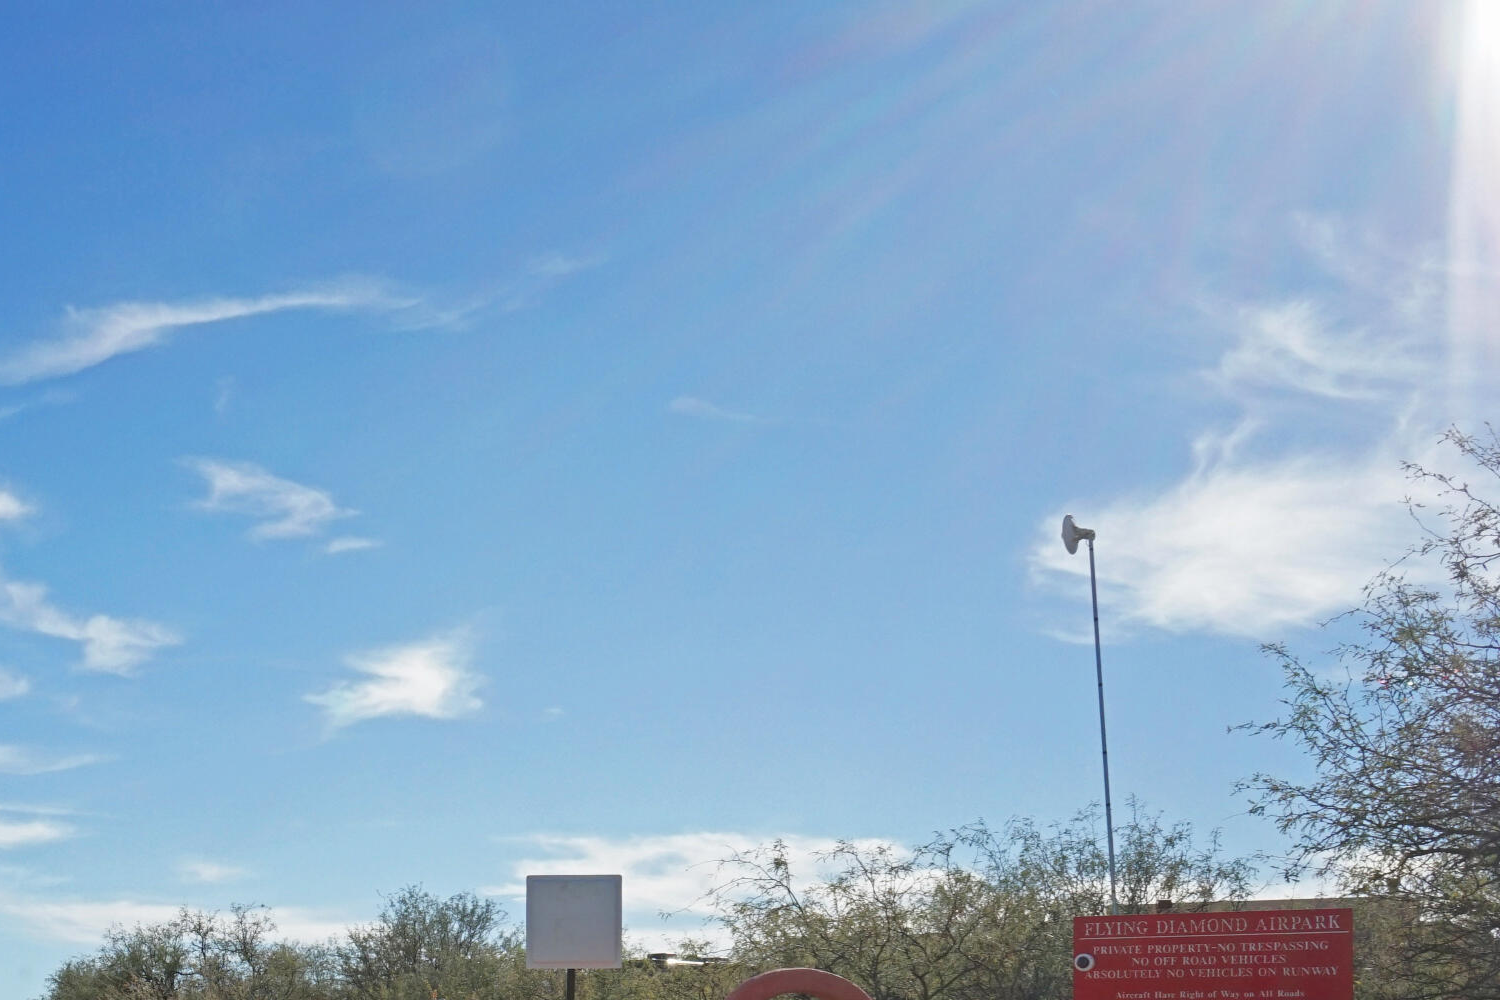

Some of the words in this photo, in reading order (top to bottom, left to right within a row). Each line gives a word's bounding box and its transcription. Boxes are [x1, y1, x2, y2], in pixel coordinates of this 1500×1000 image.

[1085, 921, 1148, 936] FLYING
[1157, 918, 1247, 934] DIAMOND
[1256, 915, 1340, 930] AIRPARK
[1093, 945, 1142, 954] PRIVATE
[1148, 944, 1236, 954] PROPERTY-NO
[1241, 941, 1329, 952] TRESPASSING
[1132, 958, 1148, 966] NO
[1154, 957, 1177, 965] OFF
[1182, 956, 1216, 965] ROAD
[1222, 955, 1286, 964] VEHICLES
[1085, 969, 1161, 979] ABSOLUTELY
[1168, 969, 1184, 977] NO
[1190, 968, 1252, 977] VEHICLES
[1258, 968, 1276, 976] ON
[1283, 966, 1339, 976] RUNWAY
[1180, 991, 1204, 999] Right
[1220, 991, 1240, 999] Way
